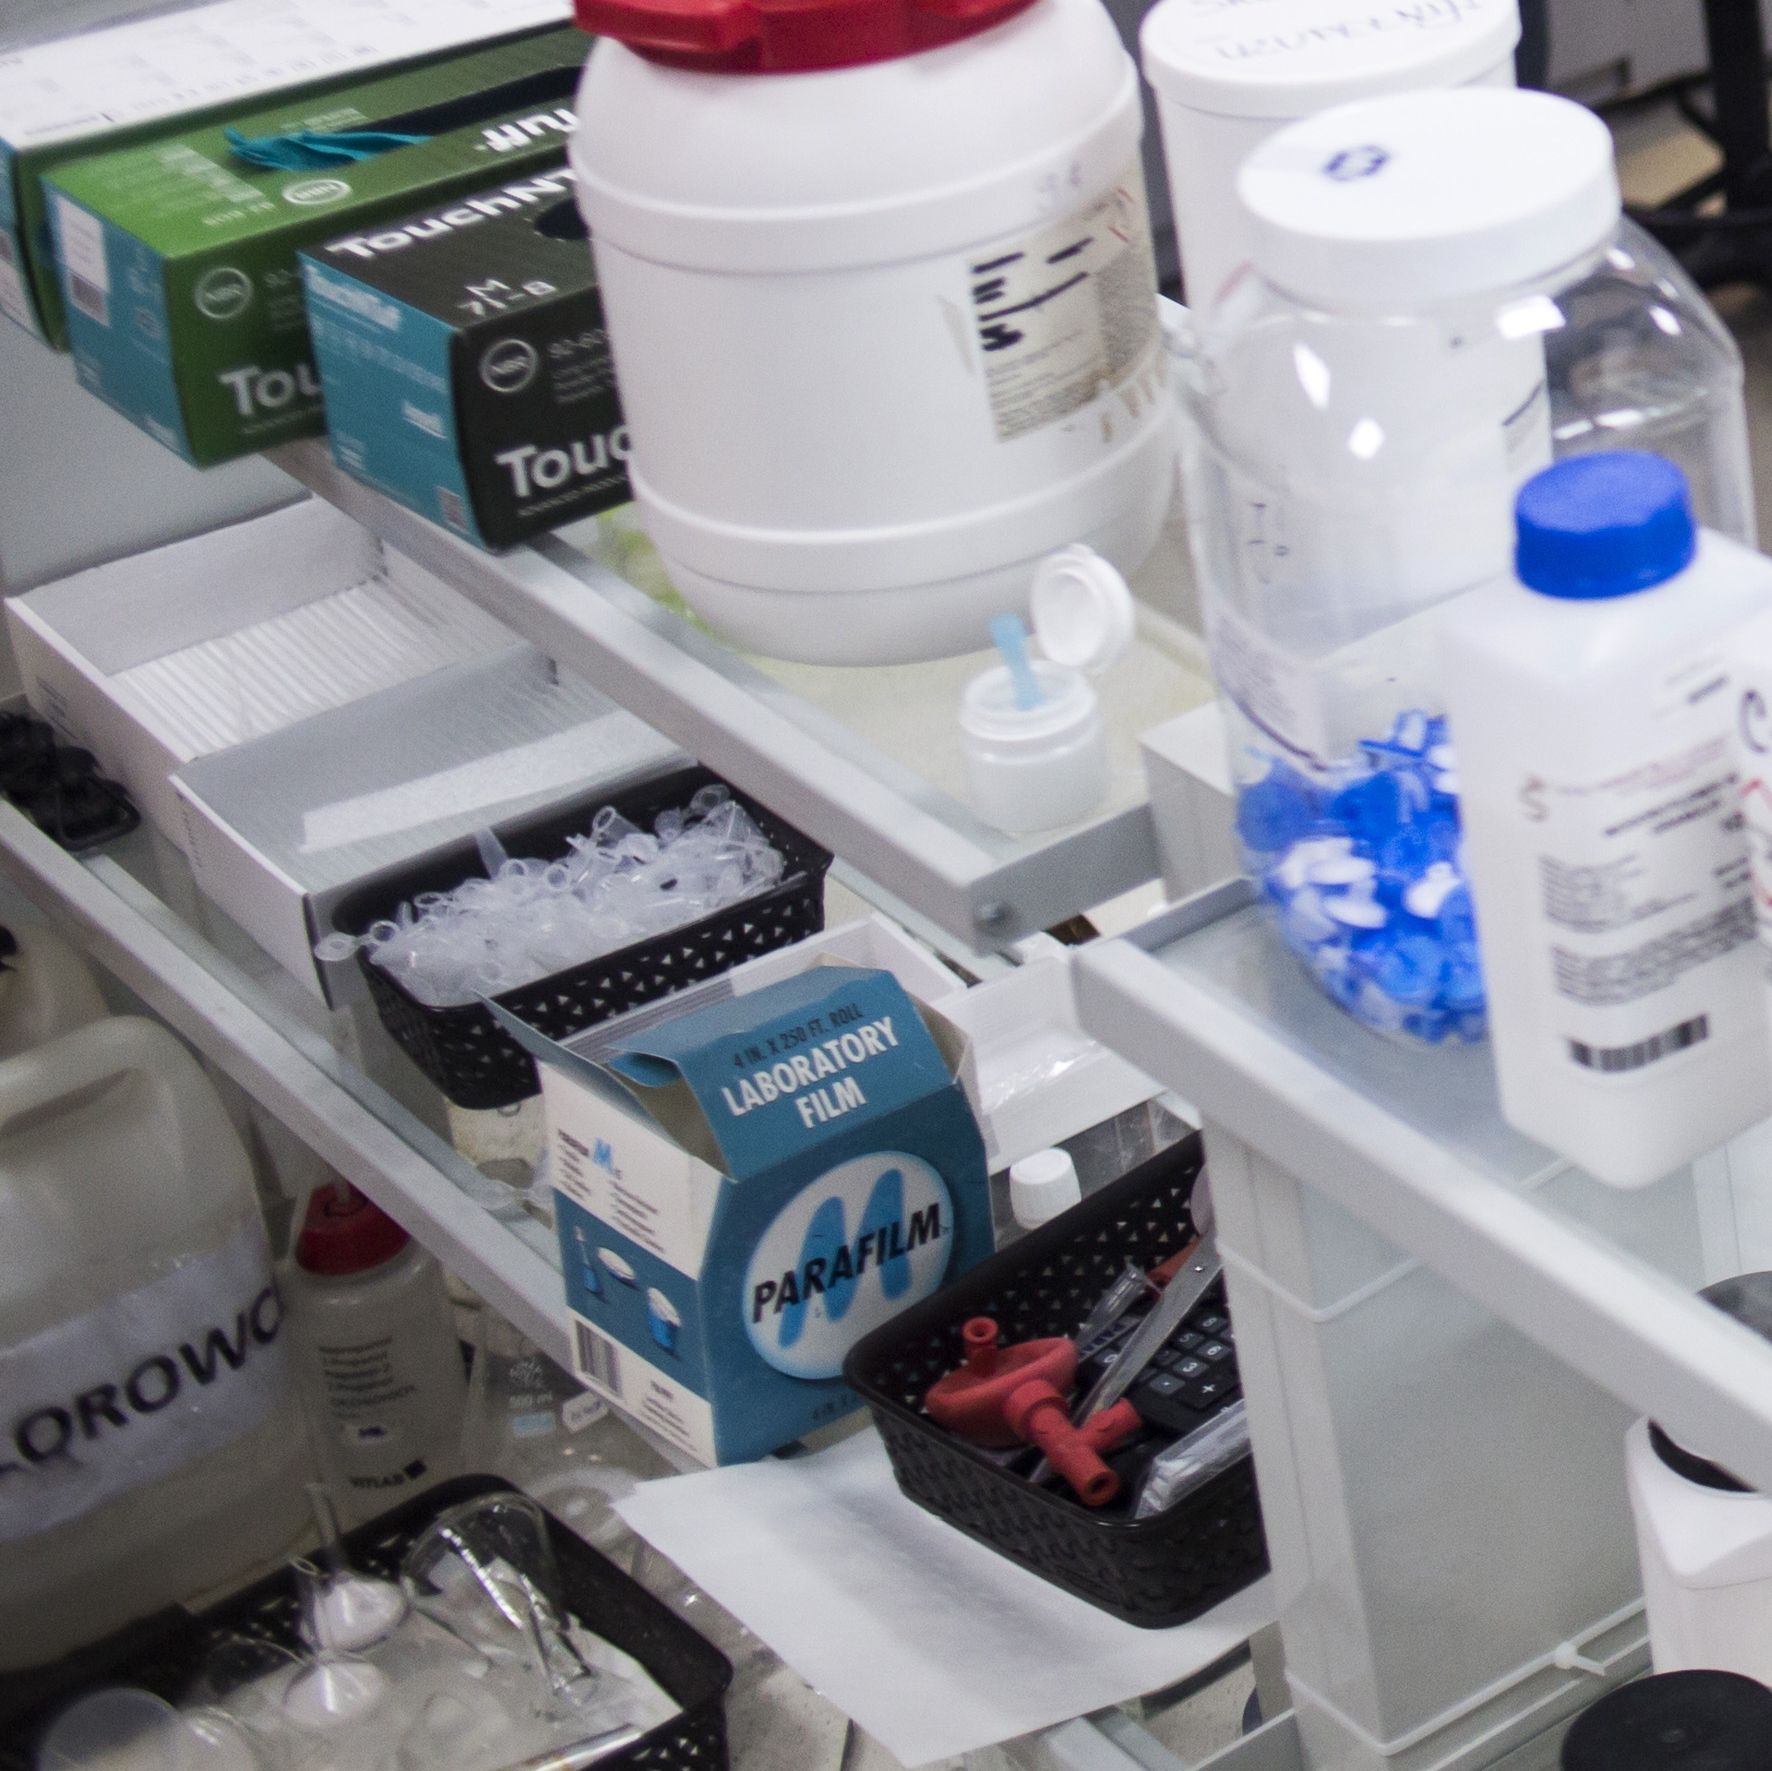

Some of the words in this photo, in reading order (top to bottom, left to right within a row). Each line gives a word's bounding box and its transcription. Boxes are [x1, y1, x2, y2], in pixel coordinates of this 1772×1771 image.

[778, 1026, 808, 1051] 250
[828, 1002, 865, 1028] ROLL
[720, 1016, 900, 1117] LABORATORY
[794, 1076, 868, 1129] FILM
[752, 1202, 942, 1324] PARAFILM
